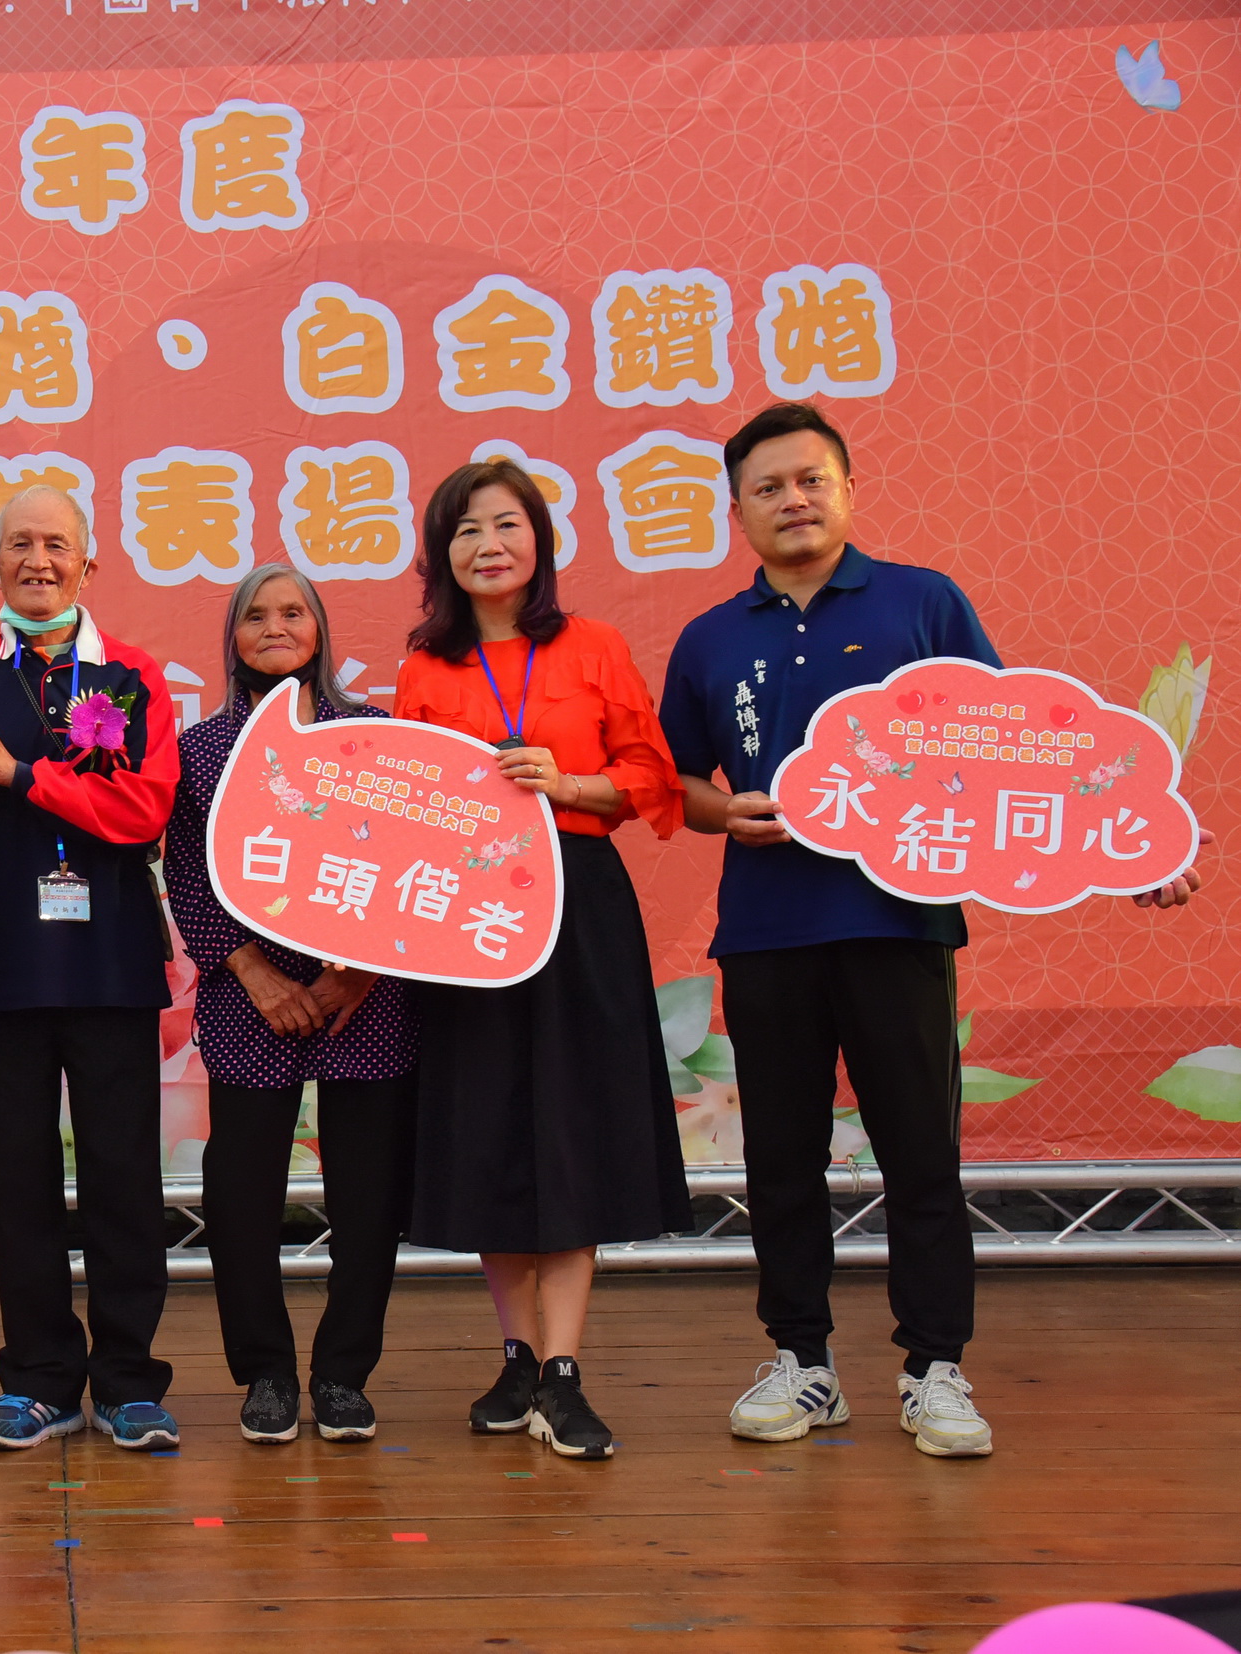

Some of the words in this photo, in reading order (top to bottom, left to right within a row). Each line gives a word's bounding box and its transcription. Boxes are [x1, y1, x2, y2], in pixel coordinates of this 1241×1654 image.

[734, 679, 761, 758] 聶博科
[957, 703, 1026, 721] 111年度
[376, 755, 442, 781] 111年度
[804, 763, 1151, 875] 永結同心
[242, 825, 525, 962] 白頭偕老
[506, 1346, 517, 1359] M
[558, 1363, 572, 1376] M
